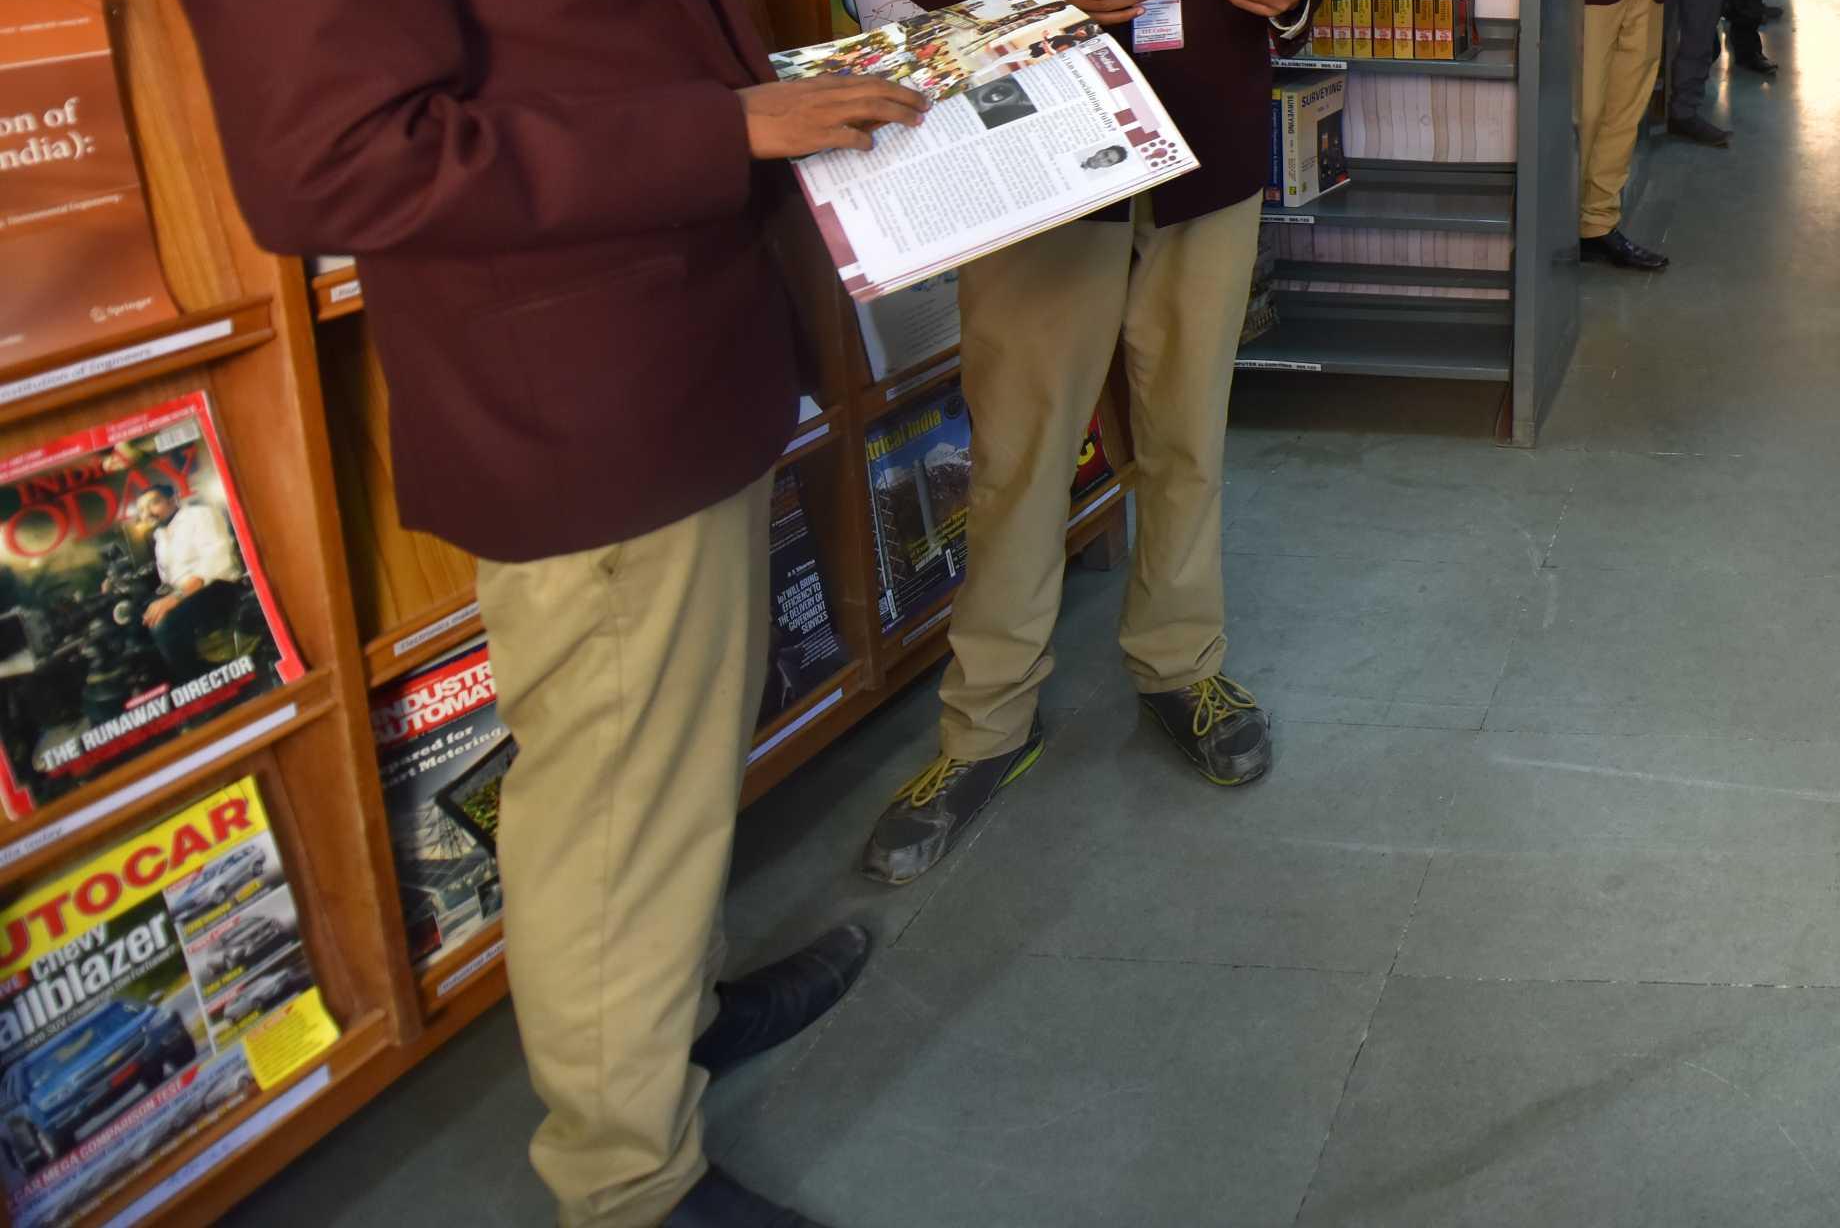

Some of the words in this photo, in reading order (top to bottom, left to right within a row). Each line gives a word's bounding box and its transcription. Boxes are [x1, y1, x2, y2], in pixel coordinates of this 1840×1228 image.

[43, 97, 79, 128] of
[1301, 81, 1343, 107] SURVEYING
[1287, 95, 1295, 134] SURVEYING
[0, 131, 96, 170] ndia):
[106, 296, 154, 318] Springer
[0, 372, 73, 399] nstitution
[4, 443, 198, 558] ODAY
[783, 588, 812, 613] EFFICIENCY
[813, 582, 821, 593] TO
[787, 582, 800, 598] WILL
[800, 572, 819, 589] BRING
[778, 613, 790, 628] THE
[789, 597, 816, 620] DELIVERY
[815, 592, 823, 602] OF
[789, 601, 826, 632] GOVERNMENT
[801, 611, 828, 634] SERVICES
[373, 660, 494, 720] INDUSTR
[41, 744, 81, 772] THE
[81, 698, 171, 751] RUNAWAY
[170, 654, 255, 708] DIRECTOR
[377, 677, 497, 742] AUTOMAT
[419, 727, 501, 773] Metering
[446, 726, 474, 745] for
[0, 797, 251, 968] UTOCAR
[31, 921, 108, 982] Chevy
[0, 911, 169, 1048] ailblazer
